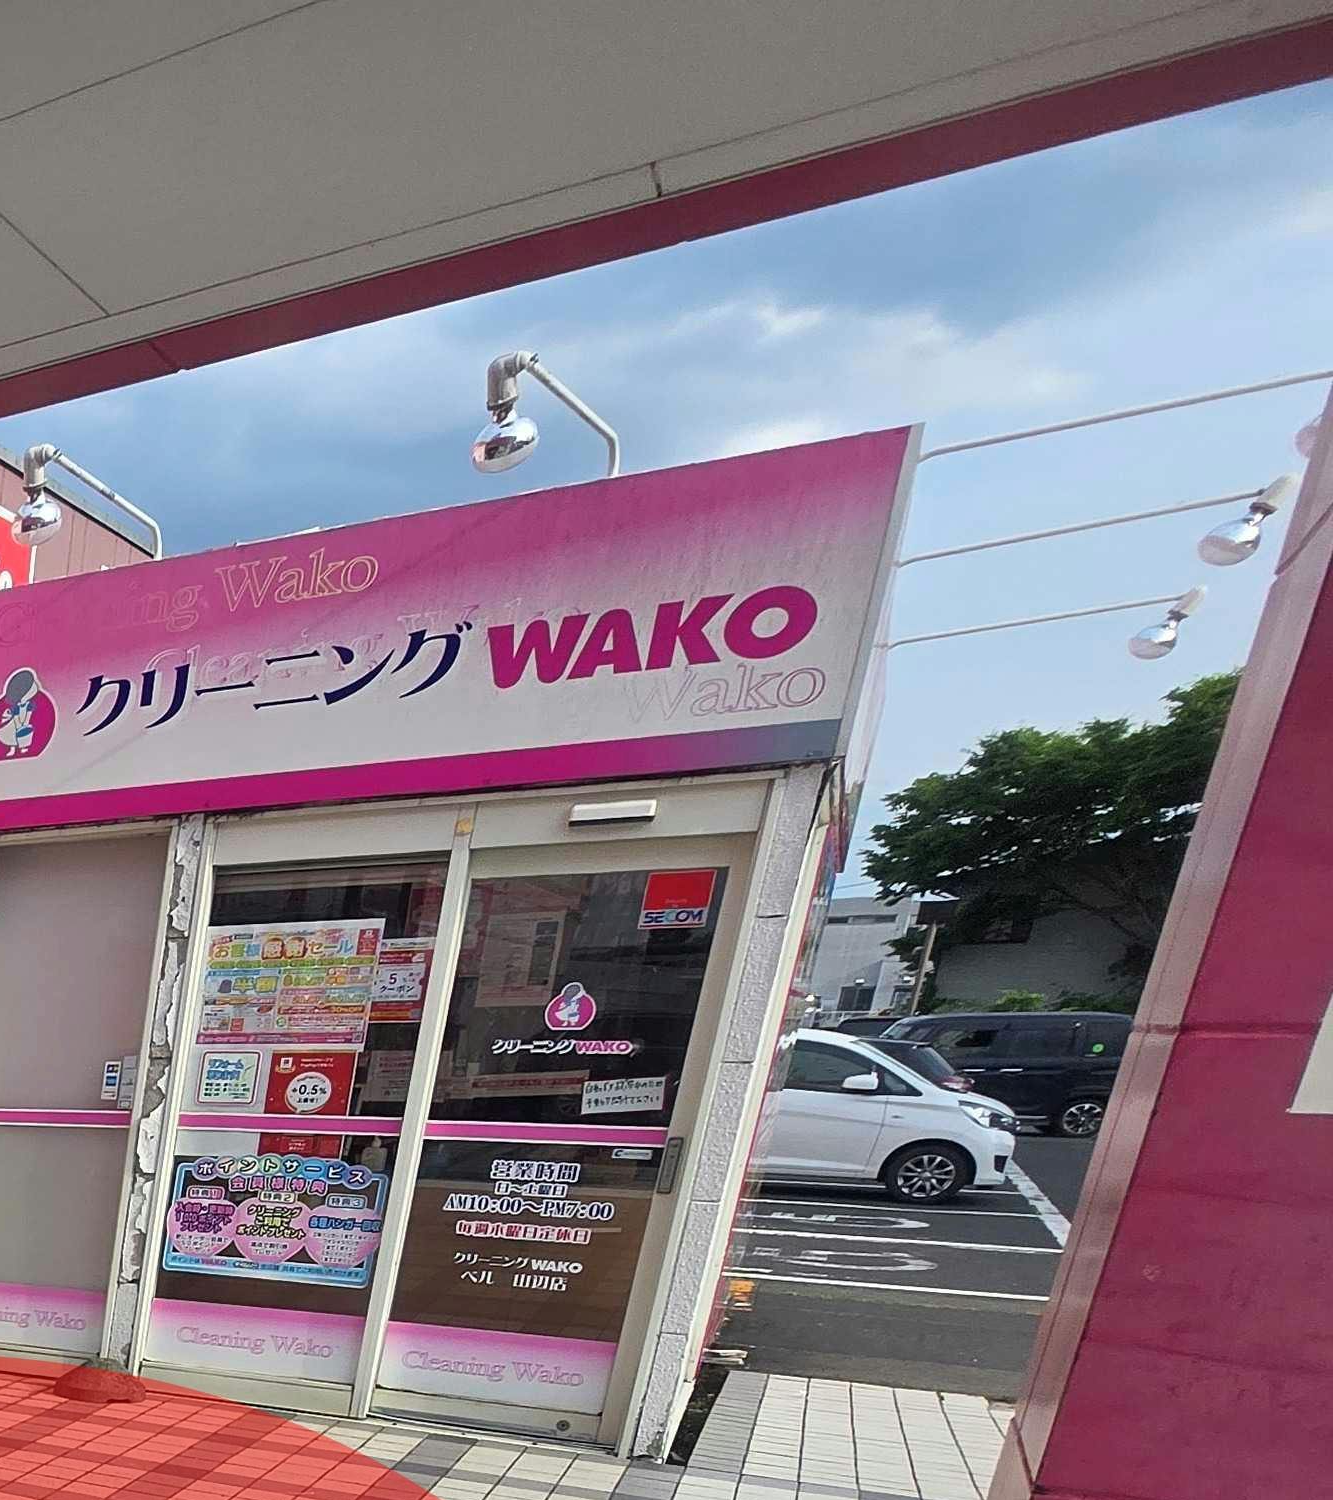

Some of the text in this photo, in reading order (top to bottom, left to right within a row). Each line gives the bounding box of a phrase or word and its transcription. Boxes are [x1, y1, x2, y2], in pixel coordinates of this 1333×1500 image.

[214, 547, 379, 613] Wako
[76, 585, 819, 736] クリーニング WAKO
[643, 910, 704, 924] SECOM
[380, 985, 415, 994] クーポン
[491, 1038, 633, 1055] クリーニング WAKO
[208, 1058, 245, 1070] リフォーム
[197, 1158, 367, 1185] ポイントサービス
[491, 1159, 581, 1182] 営業時間
[230, 1176, 327, 1195] 会員様特典
[247, 1204, 303, 1219] クリーニング
[180, 1222, 223, 1234] プレゼント
[254, 1216, 292, 1227] ご利用で
[309, 1215, 382, 1232] 各種ハンガー回収
[236, 1224, 306, 1240] ポイントプレゼント
[456, 1220, 592, 1245] 毎週水曜日定休日
[453, 1251, 583, 1274] クリーニング WAKO
[512, 1273, 568, 1292] 山辺店
[33, 1309, 86, 1331] Wako
[176, 1325, 331, 1358] Cleaning Wako
[401, 1351, 584, 1387] Cleaning Wako
